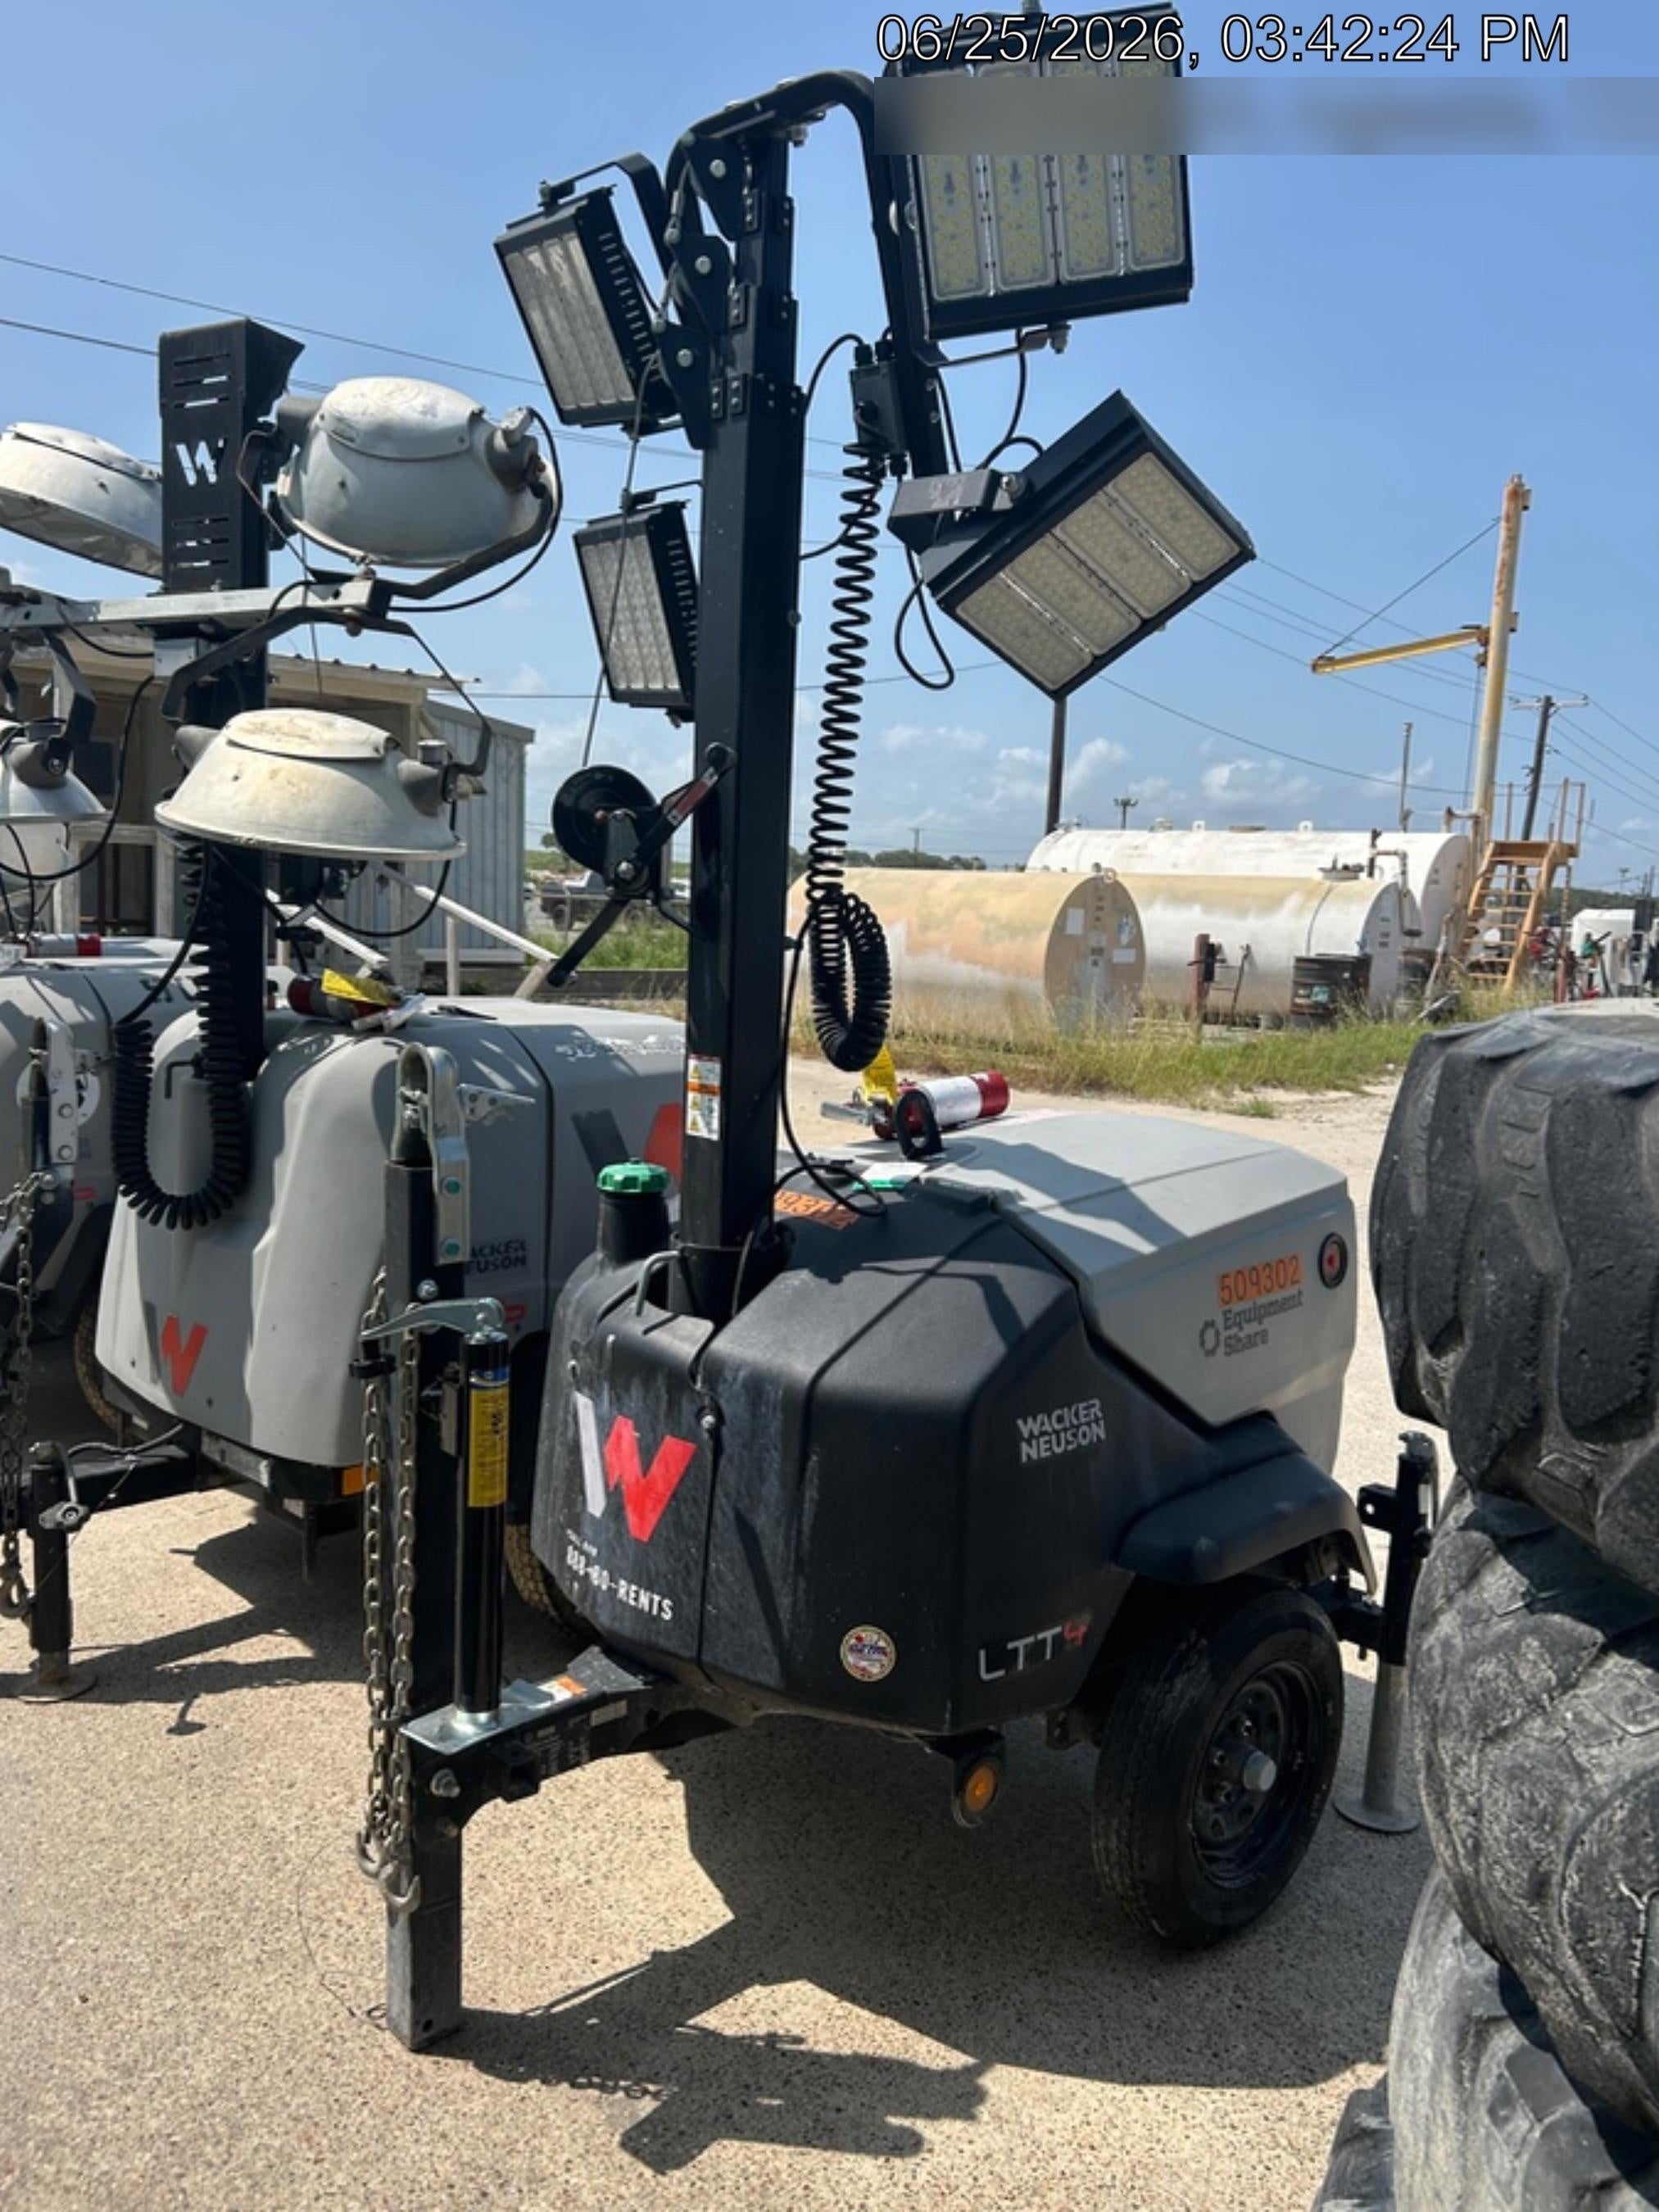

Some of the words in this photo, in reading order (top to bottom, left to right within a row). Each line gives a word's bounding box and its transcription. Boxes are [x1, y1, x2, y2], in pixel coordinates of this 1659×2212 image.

[471, 1238, 527, 1258] ACKER
[1219, 1255, 1301, 1305] 509302
[1222, 1289, 1303, 1331] Equipment
[1223, 1328, 1269, 1357] Share
[1017, 1398, 1103, 1439] WACKER
[1021, 1420, 1106, 1463] NEUSON
